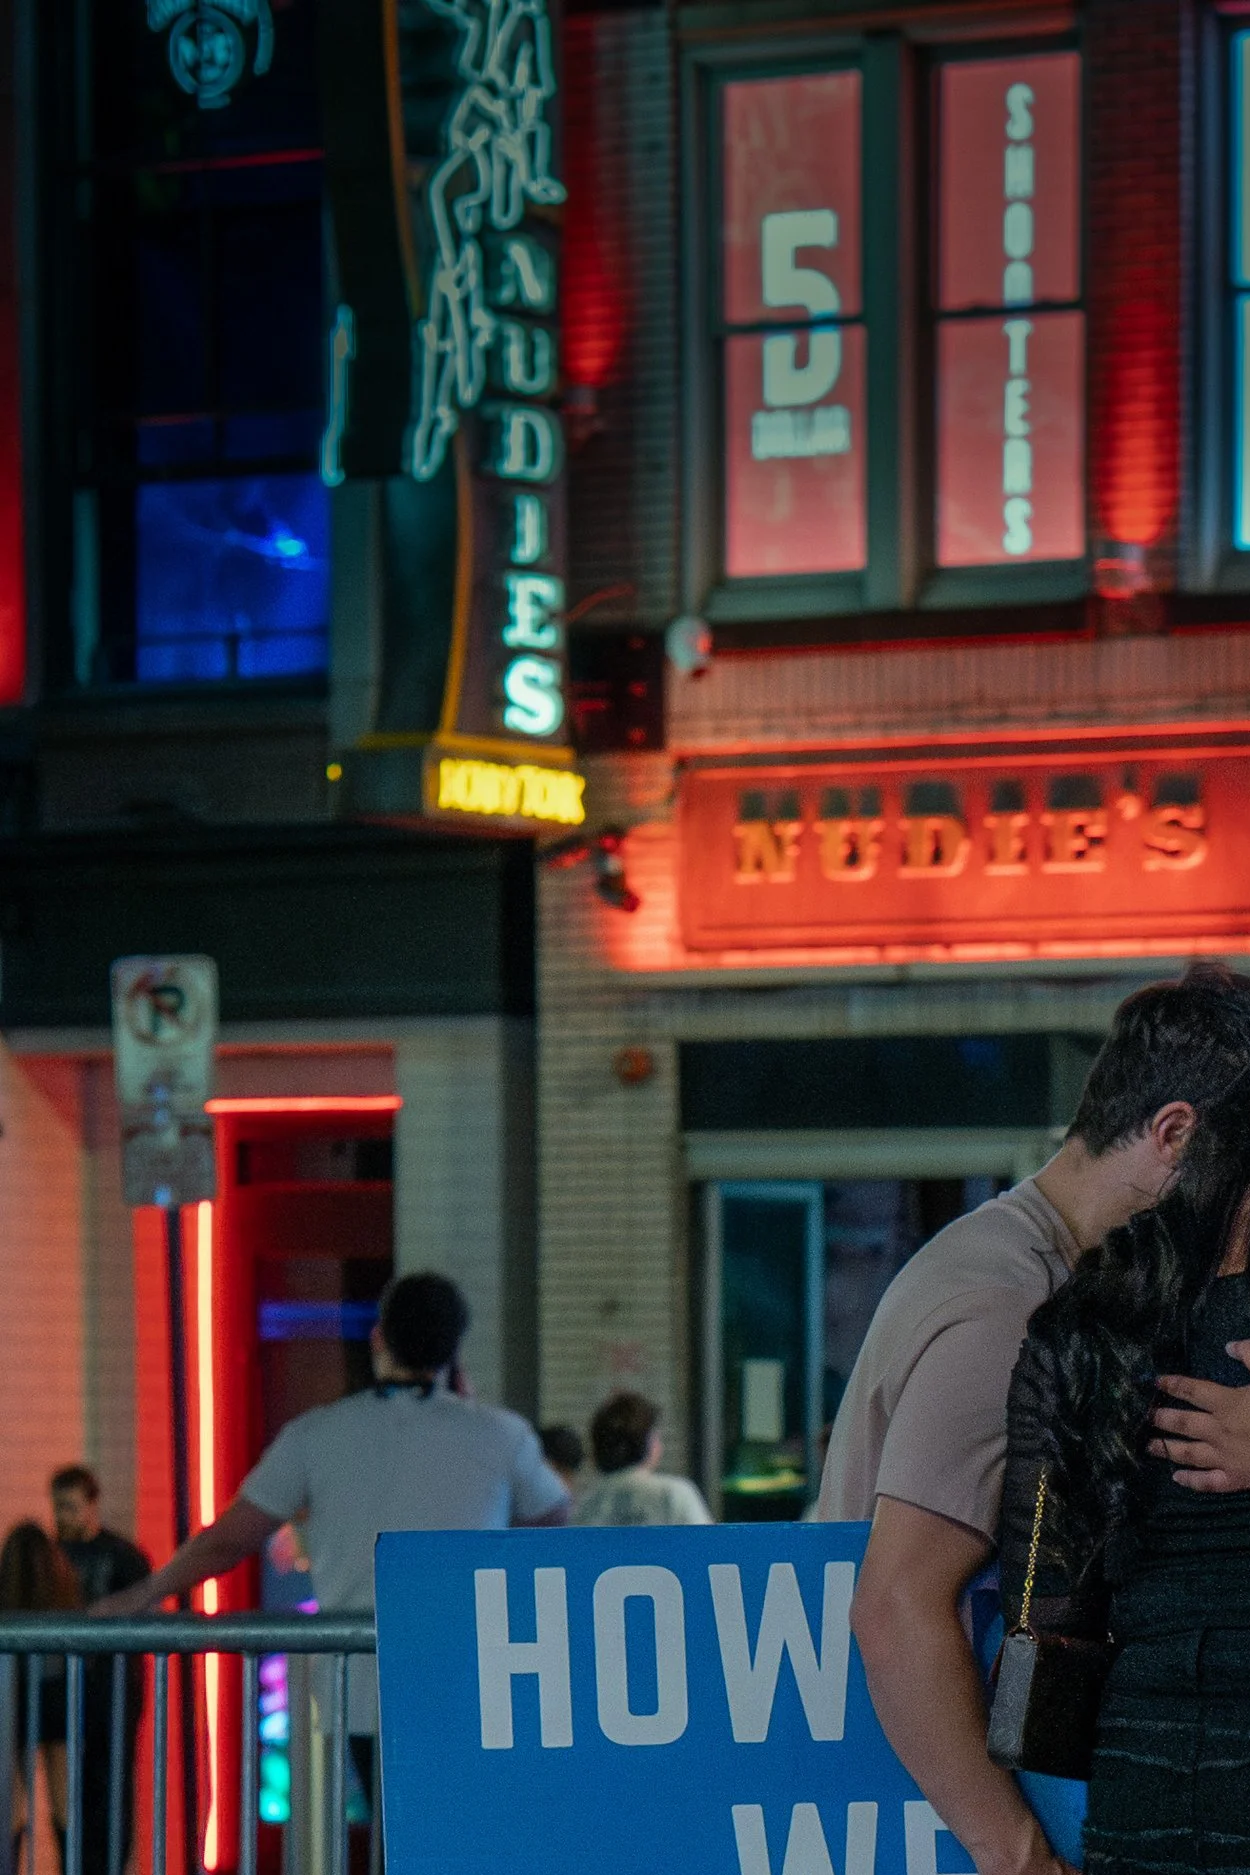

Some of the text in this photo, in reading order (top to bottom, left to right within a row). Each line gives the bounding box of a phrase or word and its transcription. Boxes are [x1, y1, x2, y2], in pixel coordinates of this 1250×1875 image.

[761, 208, 842, 408] 5
[732, 796, 1209, 884] NUDIE'S
[474, 1560, 857, 1750] HOW
